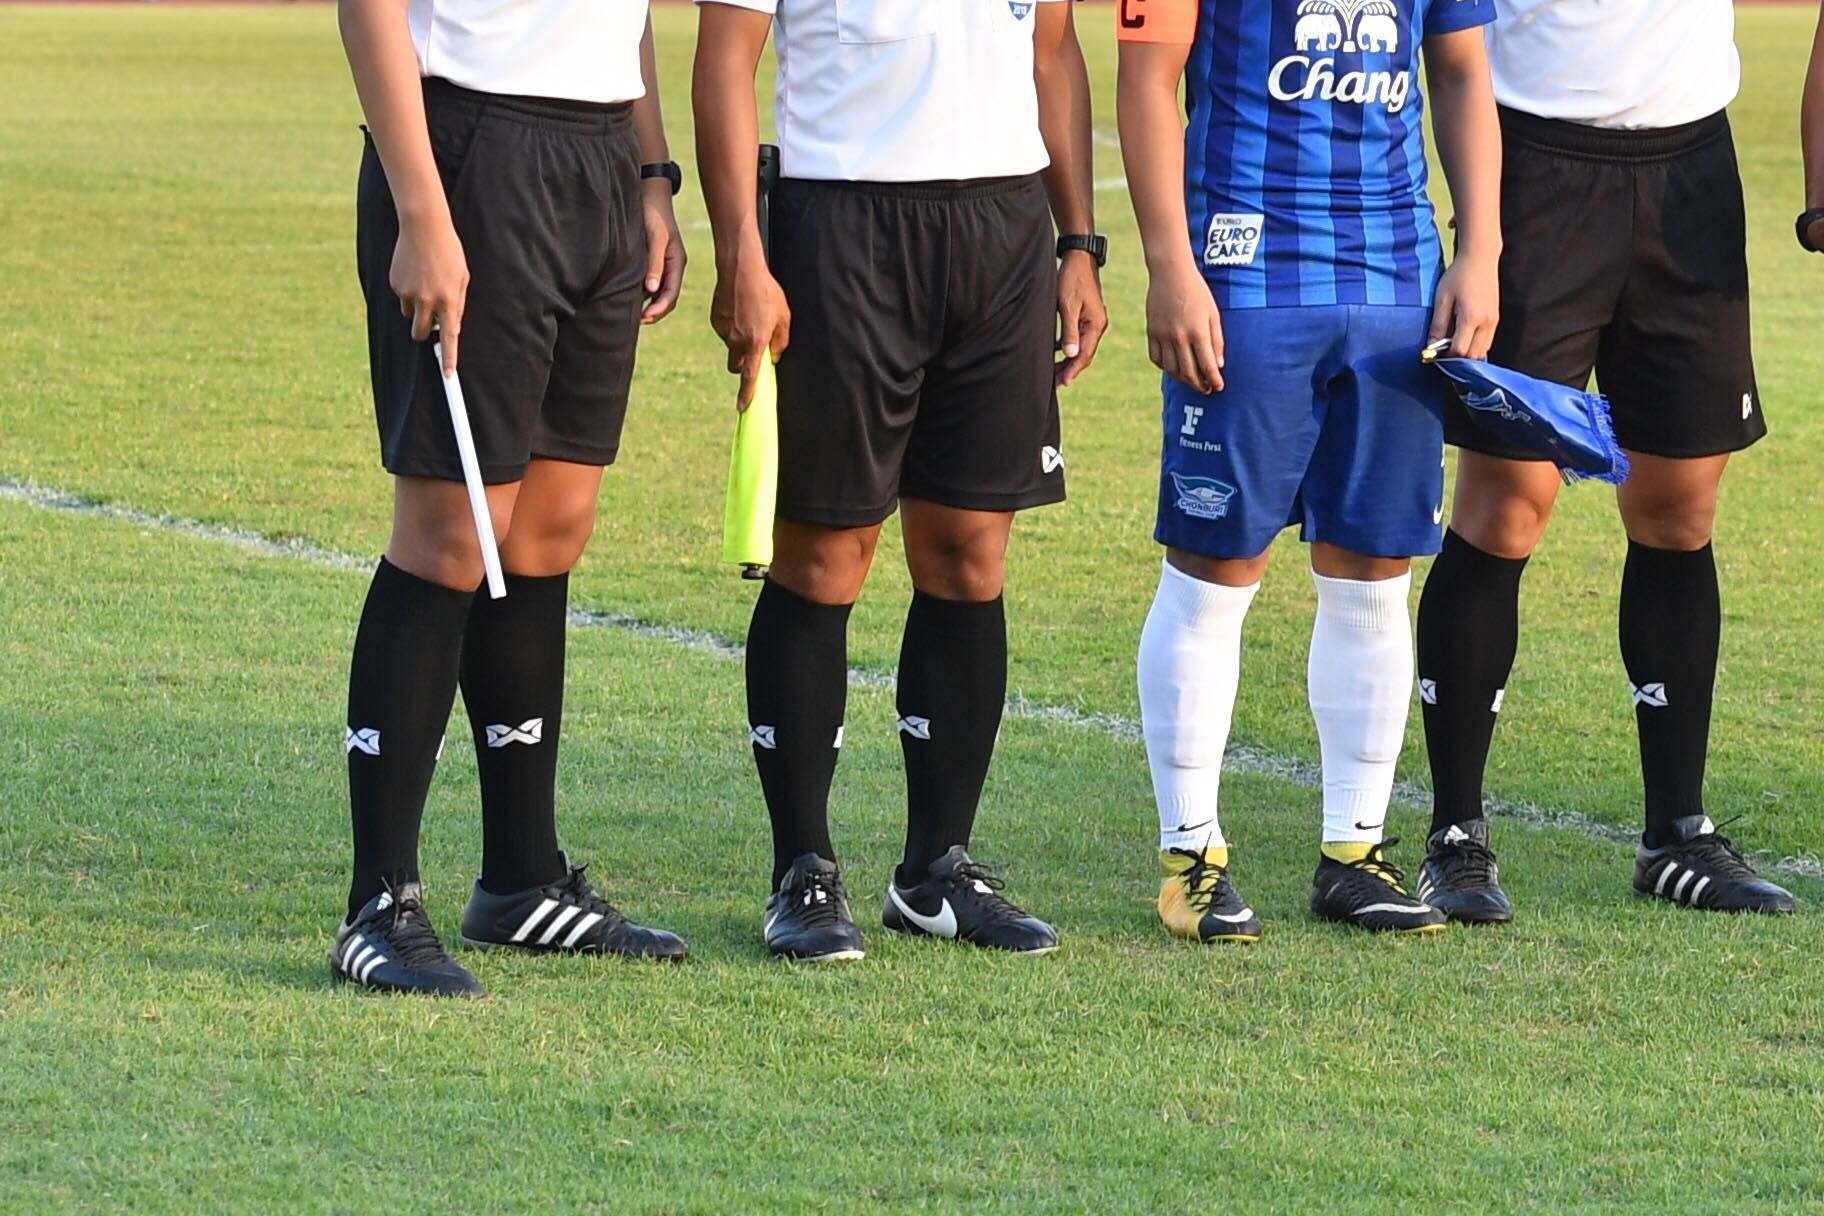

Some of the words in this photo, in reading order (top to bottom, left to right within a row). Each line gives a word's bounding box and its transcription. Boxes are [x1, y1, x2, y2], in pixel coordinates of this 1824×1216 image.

[1268, 55, 1410, 112] Chang
[1209, 226, 1258, 244] EURO
[1206, 241, 1253, 260] CAKE
[1180, 498, 1224, 514] CHONBURI
